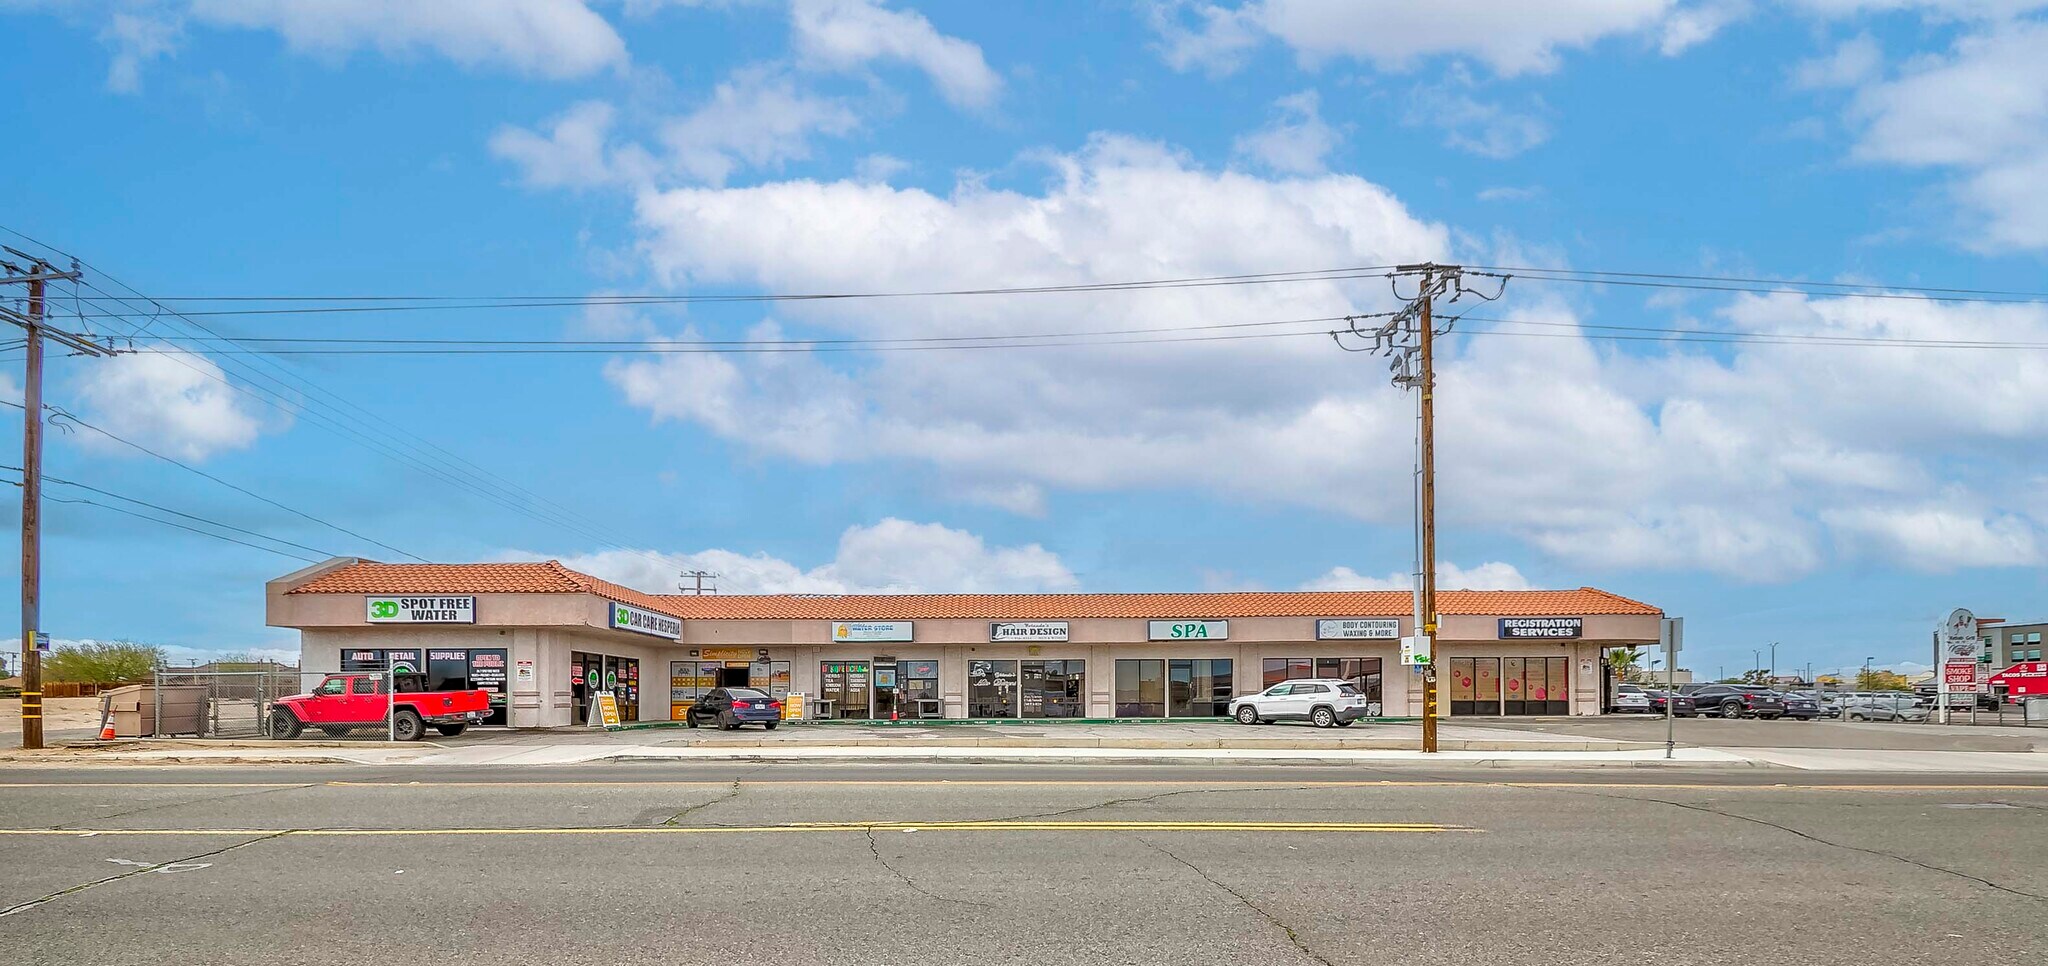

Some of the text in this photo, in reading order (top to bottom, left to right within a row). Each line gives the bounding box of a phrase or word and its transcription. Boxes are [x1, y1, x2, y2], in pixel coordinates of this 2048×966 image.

[401, 598, 470, 610] SPOT FREE
[371, 601, 399, 619] 3D
[411, 610, 457, 621] WATER
[617, 608, 629, 625] 3D
[630, 611, 680, 635] CAR CARE HESPERIA
[1342, 621, 1397, 629] BODY CONTOURING
[1504, 619, 1581, 628] REGISTRATION
[1002, 627, 1066, 636] HAIR DESIGN
[1171, 624, 1208, 637] SPA
[1511, 627, 1573, 637] SERVICES
[351, 652, 374, 661] AUTO
[430, 652, 466, 660] SUPPLIES
[1946, 667, 1973, 675] SMOKE
[1947, 675, 1971, 683] SHOP
